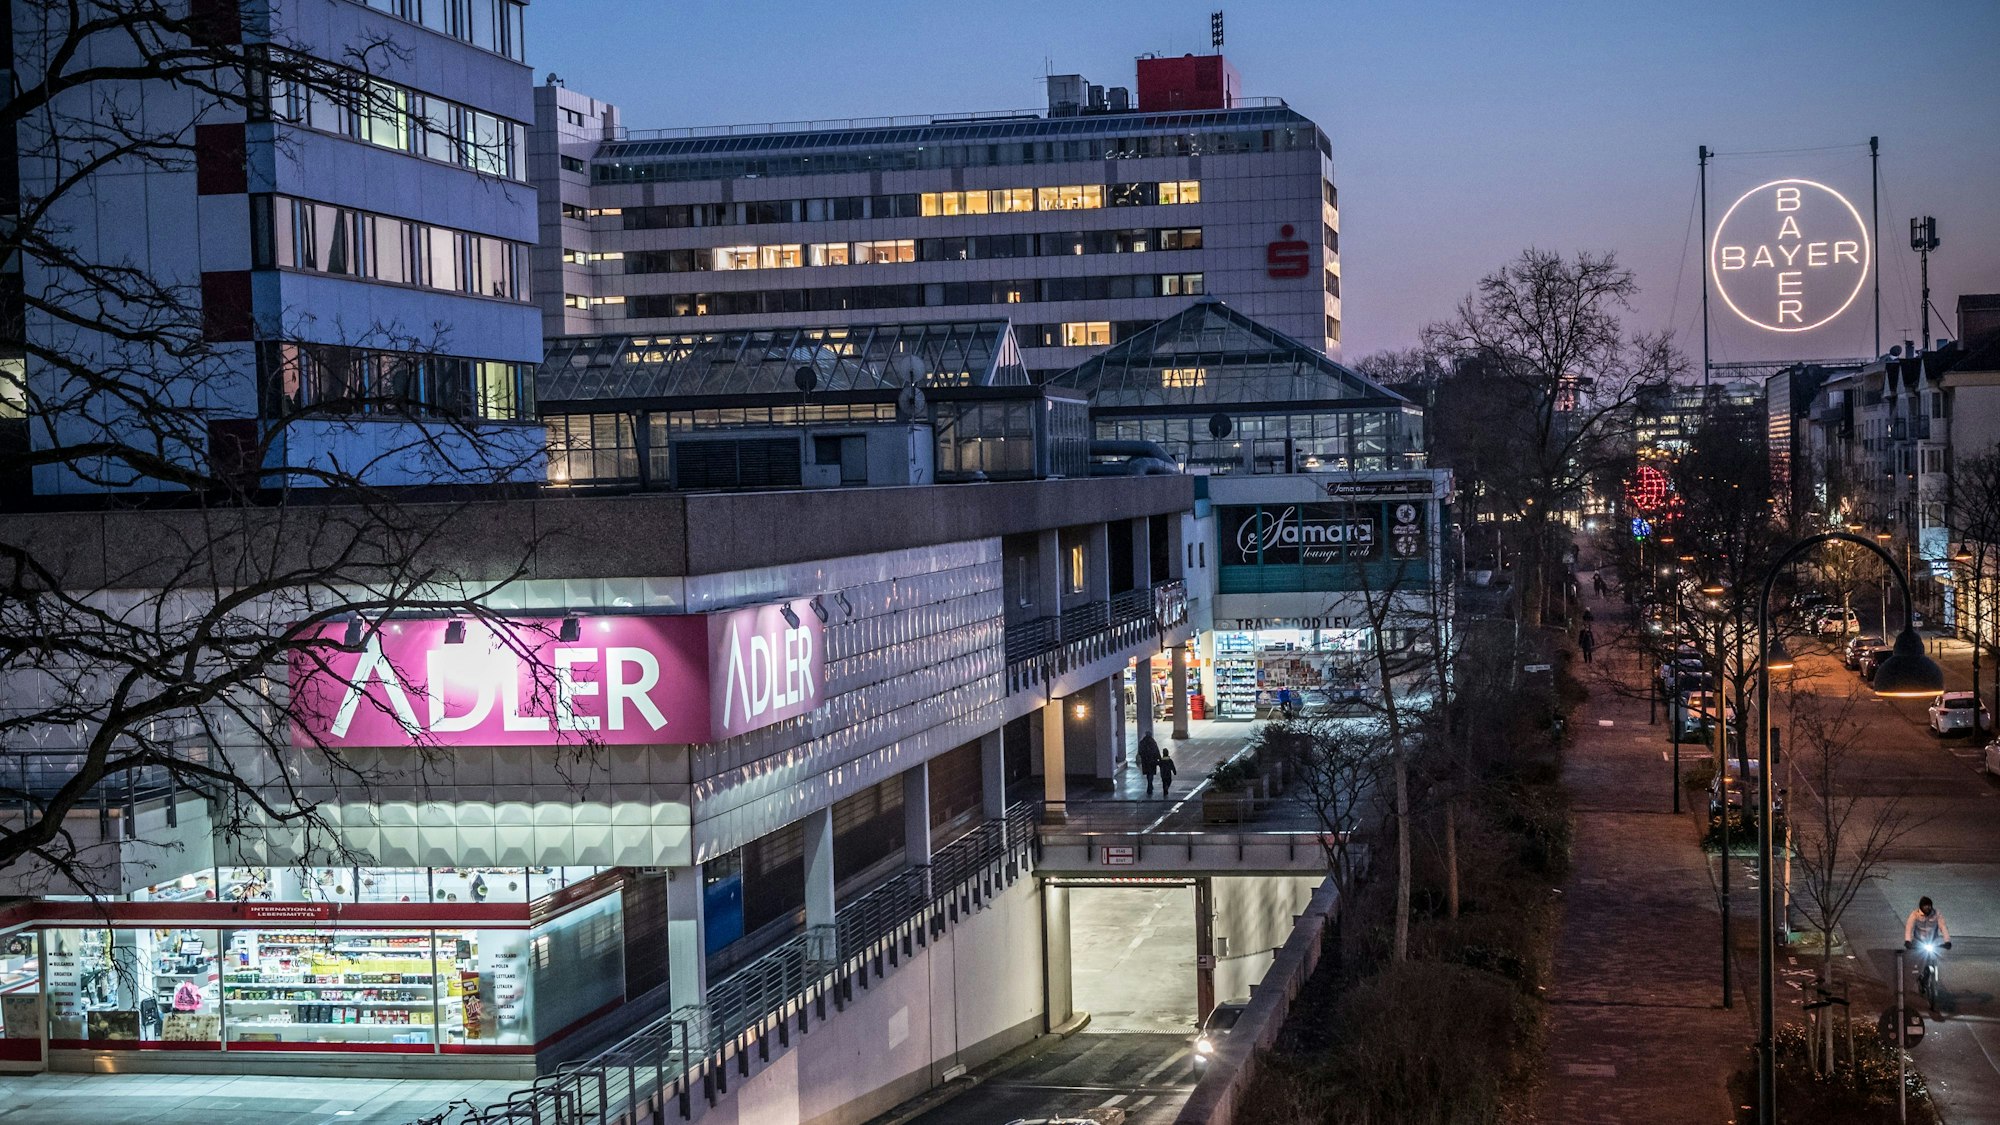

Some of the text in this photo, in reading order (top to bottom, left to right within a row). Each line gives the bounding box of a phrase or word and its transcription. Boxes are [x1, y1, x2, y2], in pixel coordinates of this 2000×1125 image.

[1722, 241, 1860, 270] BAYER
[1777, 187, 1803, 323] BAYER
[1327, 483, 1361, 494] Samaa
[1236, 505, 1371, 563] Samara
[1303, 547, 1339, 563] lounge
[1325, 616, 1352, 629] LEV
[330, 632, 669, 739] ADLER
[723, 618, 815, 730] ADLER
